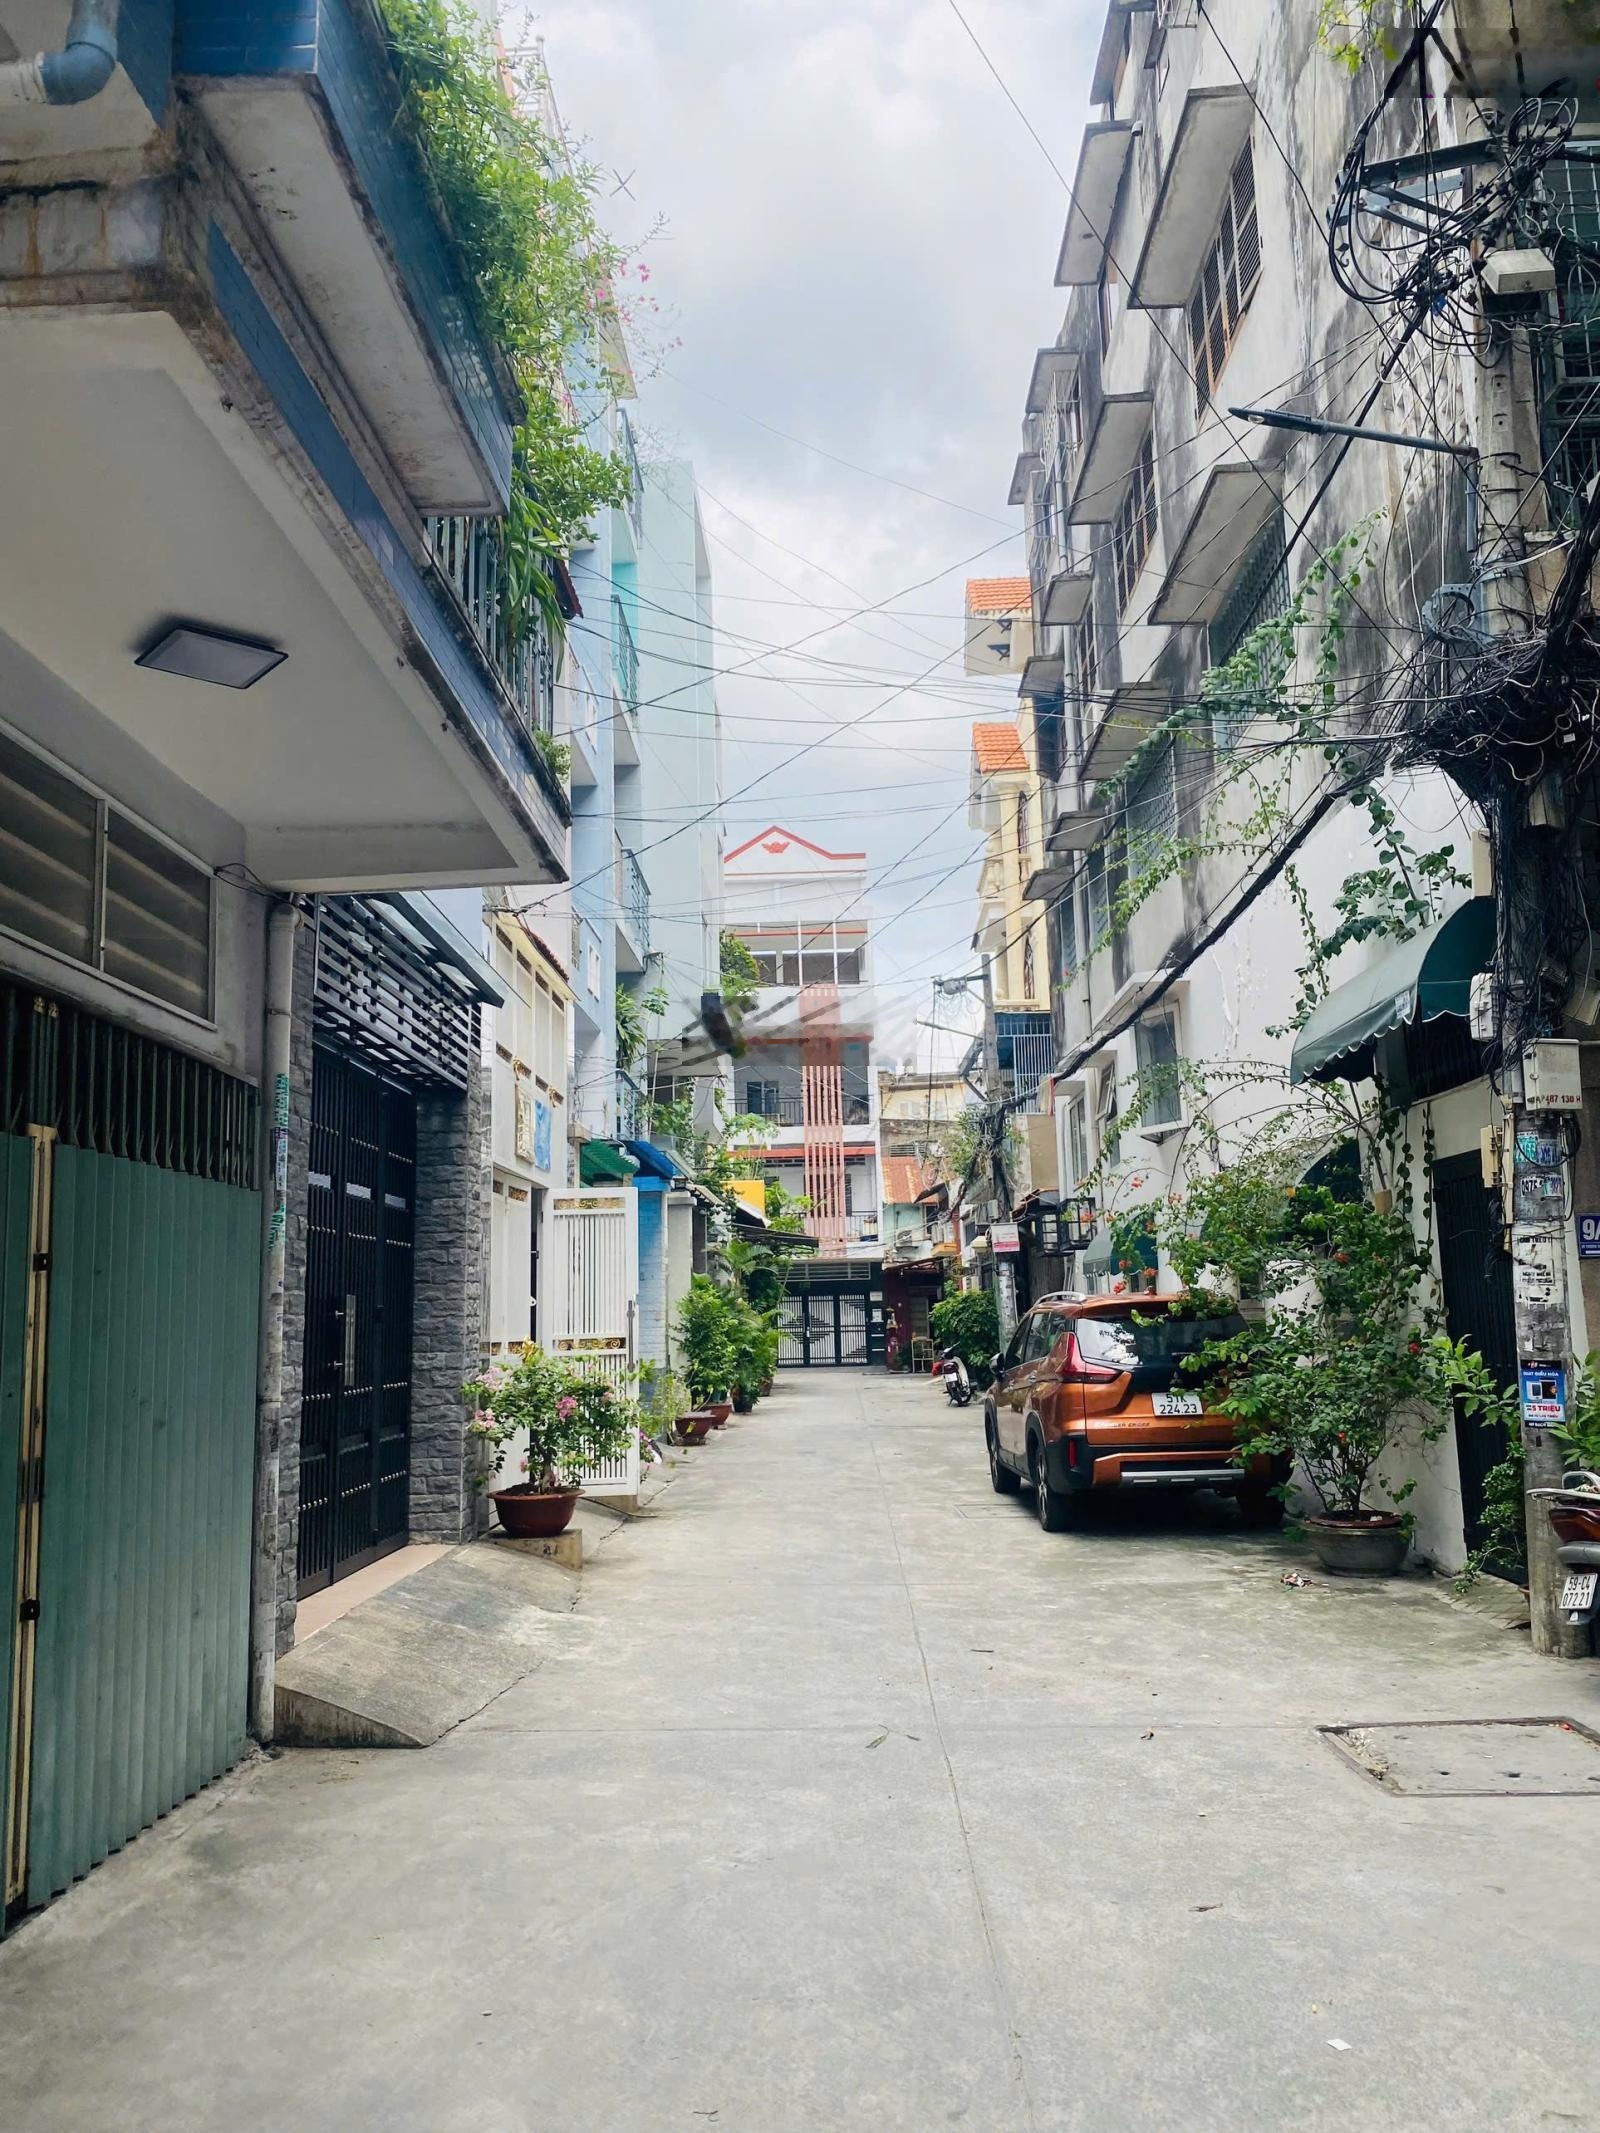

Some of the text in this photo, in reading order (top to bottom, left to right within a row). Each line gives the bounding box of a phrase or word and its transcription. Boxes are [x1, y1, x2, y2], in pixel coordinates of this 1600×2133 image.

[1160, 1404, 1197, 1414] 224.23
[1537, 1404, 1561, 1412] TRIỆU
[1568, 1576, 1590, 1591] 59-C4
